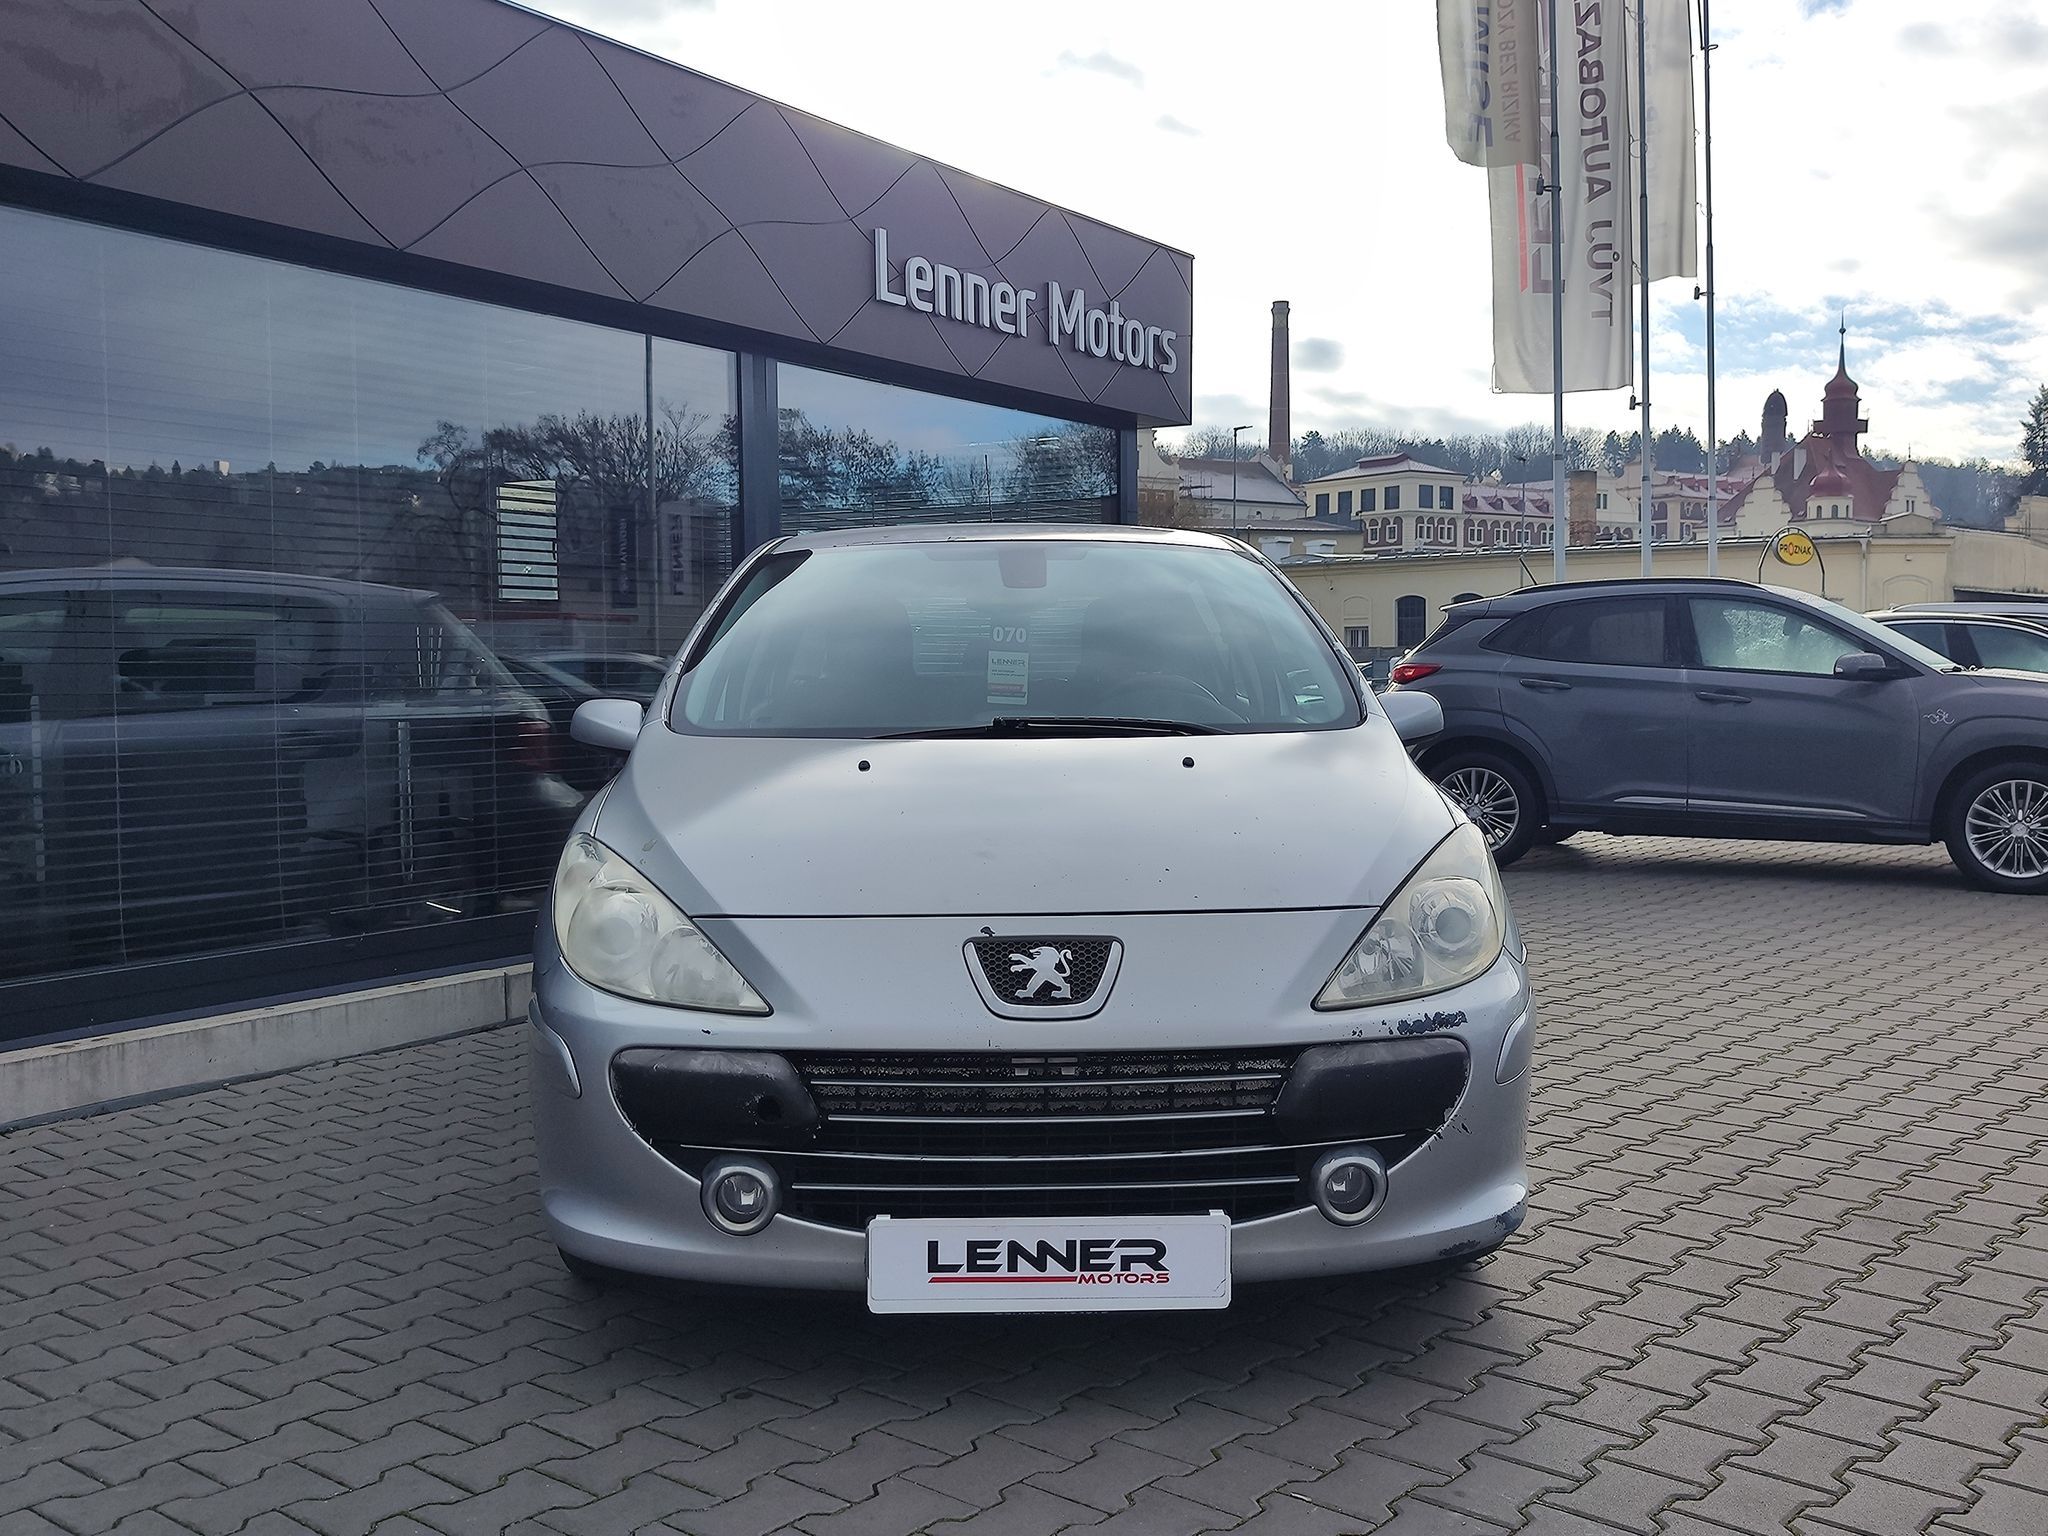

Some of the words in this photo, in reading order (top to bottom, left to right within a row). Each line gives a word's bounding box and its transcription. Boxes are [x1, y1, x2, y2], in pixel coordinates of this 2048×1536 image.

[873, 227, 1037, 338] Lenner
[1047, 280, 1178, 374] Motors
[992, 626, 1027, 643] 070
[927, 1239, 1169, 1273] LENNER
[1077, 1273, 1170, 1284] MOTORS
